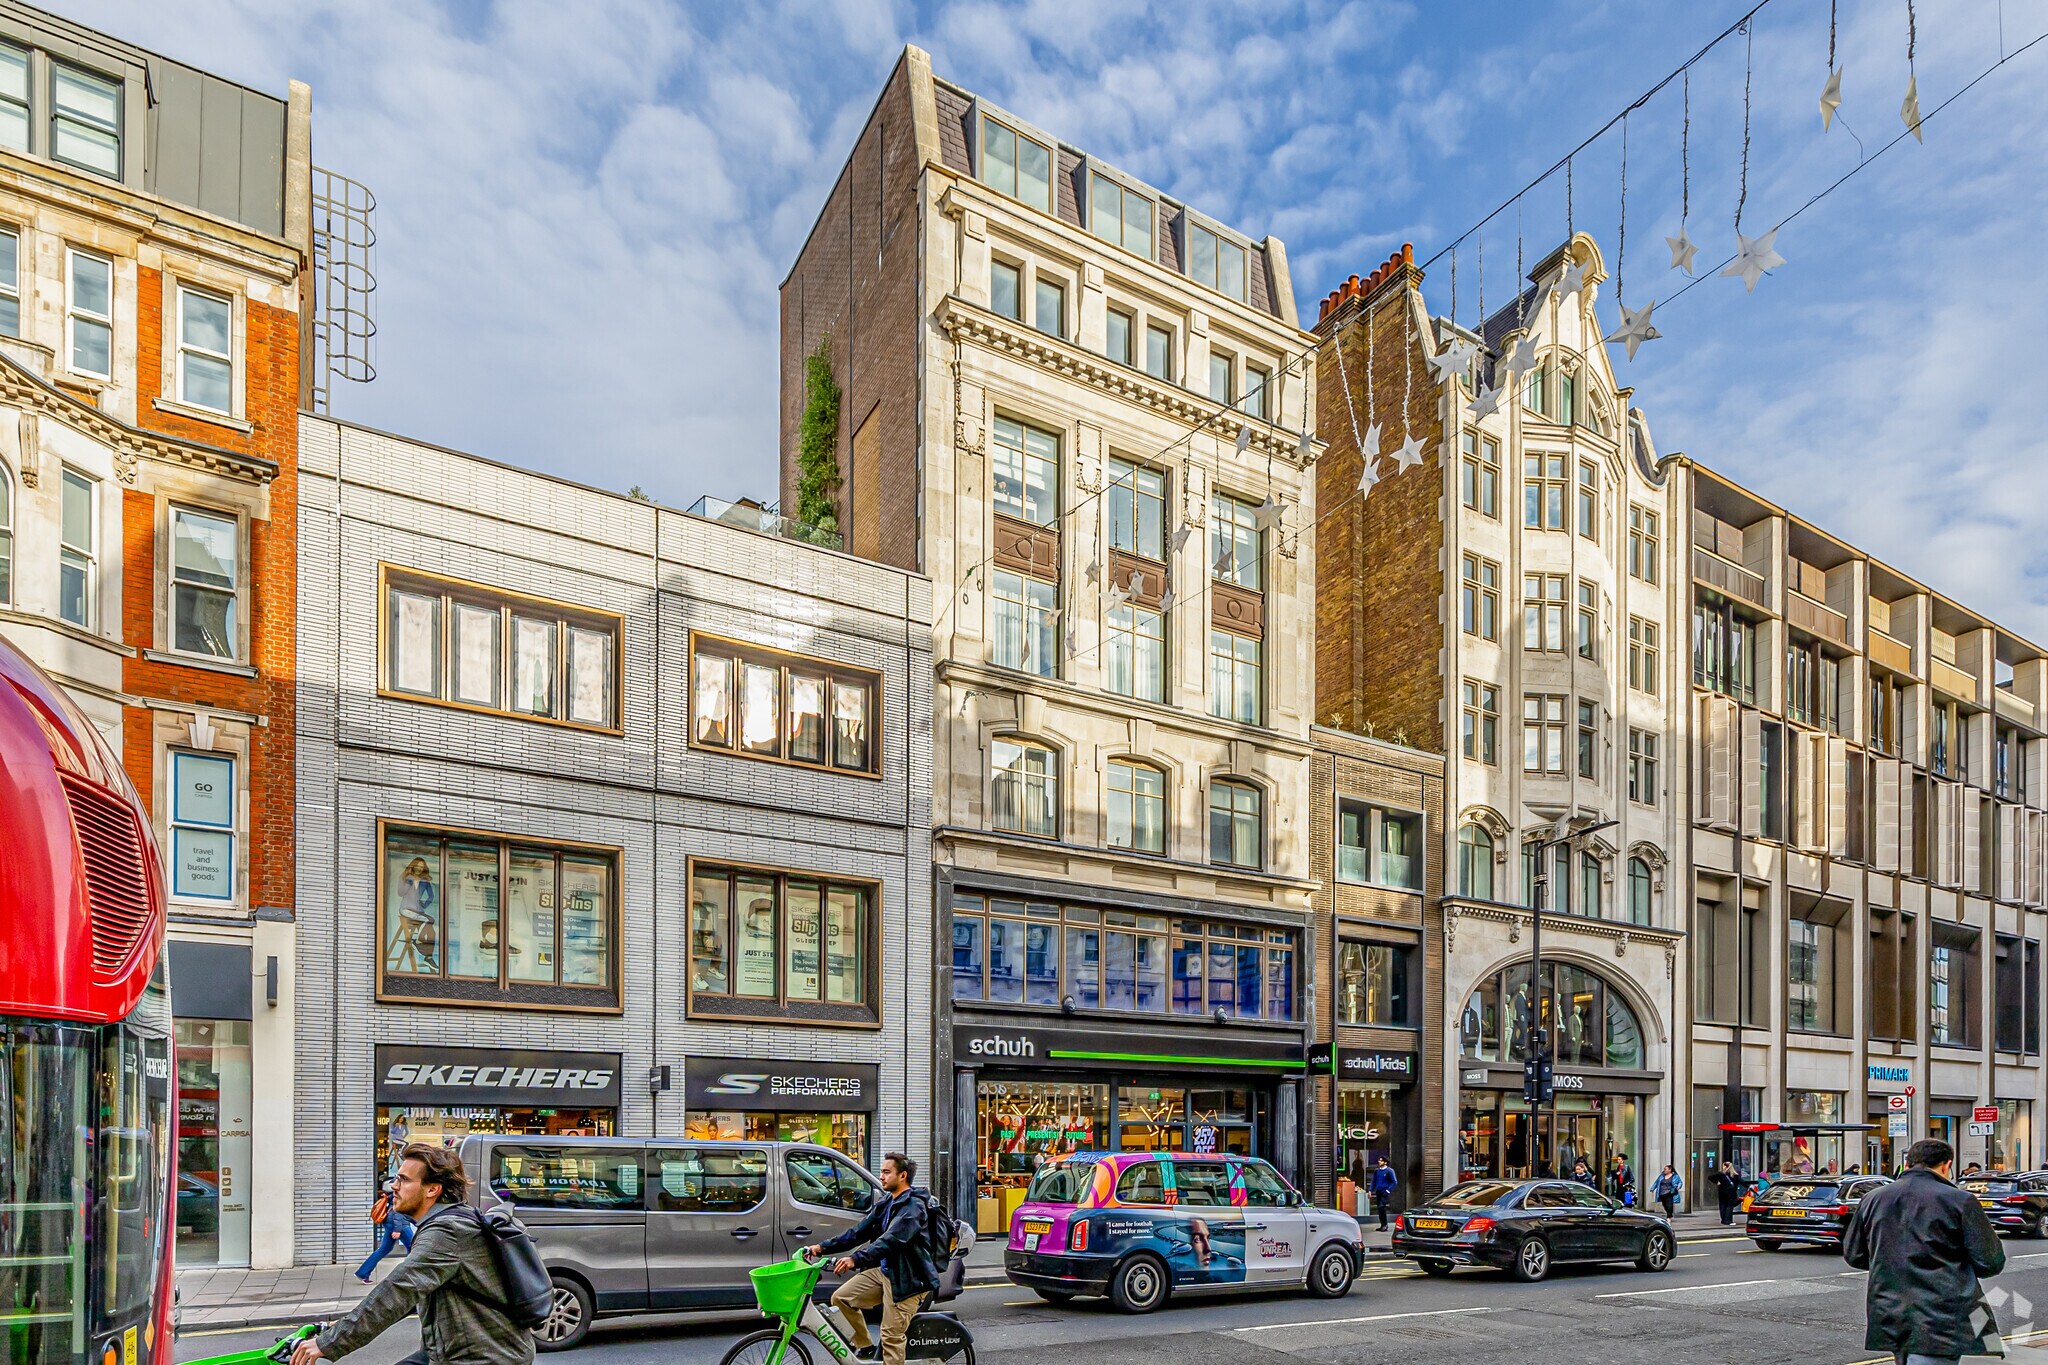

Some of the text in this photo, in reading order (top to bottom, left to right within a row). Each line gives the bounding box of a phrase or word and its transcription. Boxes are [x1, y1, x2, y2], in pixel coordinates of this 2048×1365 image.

[194, 782, 213, 792] GO
[193, 847, 214, 856] travel
[187, 863, 220, 873] business
[191, 873, 216, 881] goods
[464, 872, 491, 882] JUST
[538, 879, 597, 892] SKCHERS
[744, 949, 762, 957] JUST
[969, 1035, 1034, 1057] schuh
[1311, 1055, 1330, 1064] schuh
[1344, 1057, 1376, 1069] schuh
[383, 1064, 613, 1089] SKECHERS
[1868, 1066, 1909, 1082] PRIMARK
[771, 1076, 860, 1089] SKECHERS
[1553, 1076, 1583, 1089] MOSS
[771, 1088, 860, 1097] PERFORMANCE
[1906, 1087, 1914, 1095] V
[221, 1130, 250, 1138] CARPISA
[1000, 1130, 1015, 1138] PAST
[1066, 1131, 1087, 1139] FUTURE
[1337, 1121, 1380, 1140] kids
[1193, 1127, 1216, 1146] 25%
[1260, 1243, 1292, 1255] UNREAL
[909, 1338, 921, 1347] On
[921, 1337, 939, 1346] Lime
[944, 1336, 961, 1345] Uber
